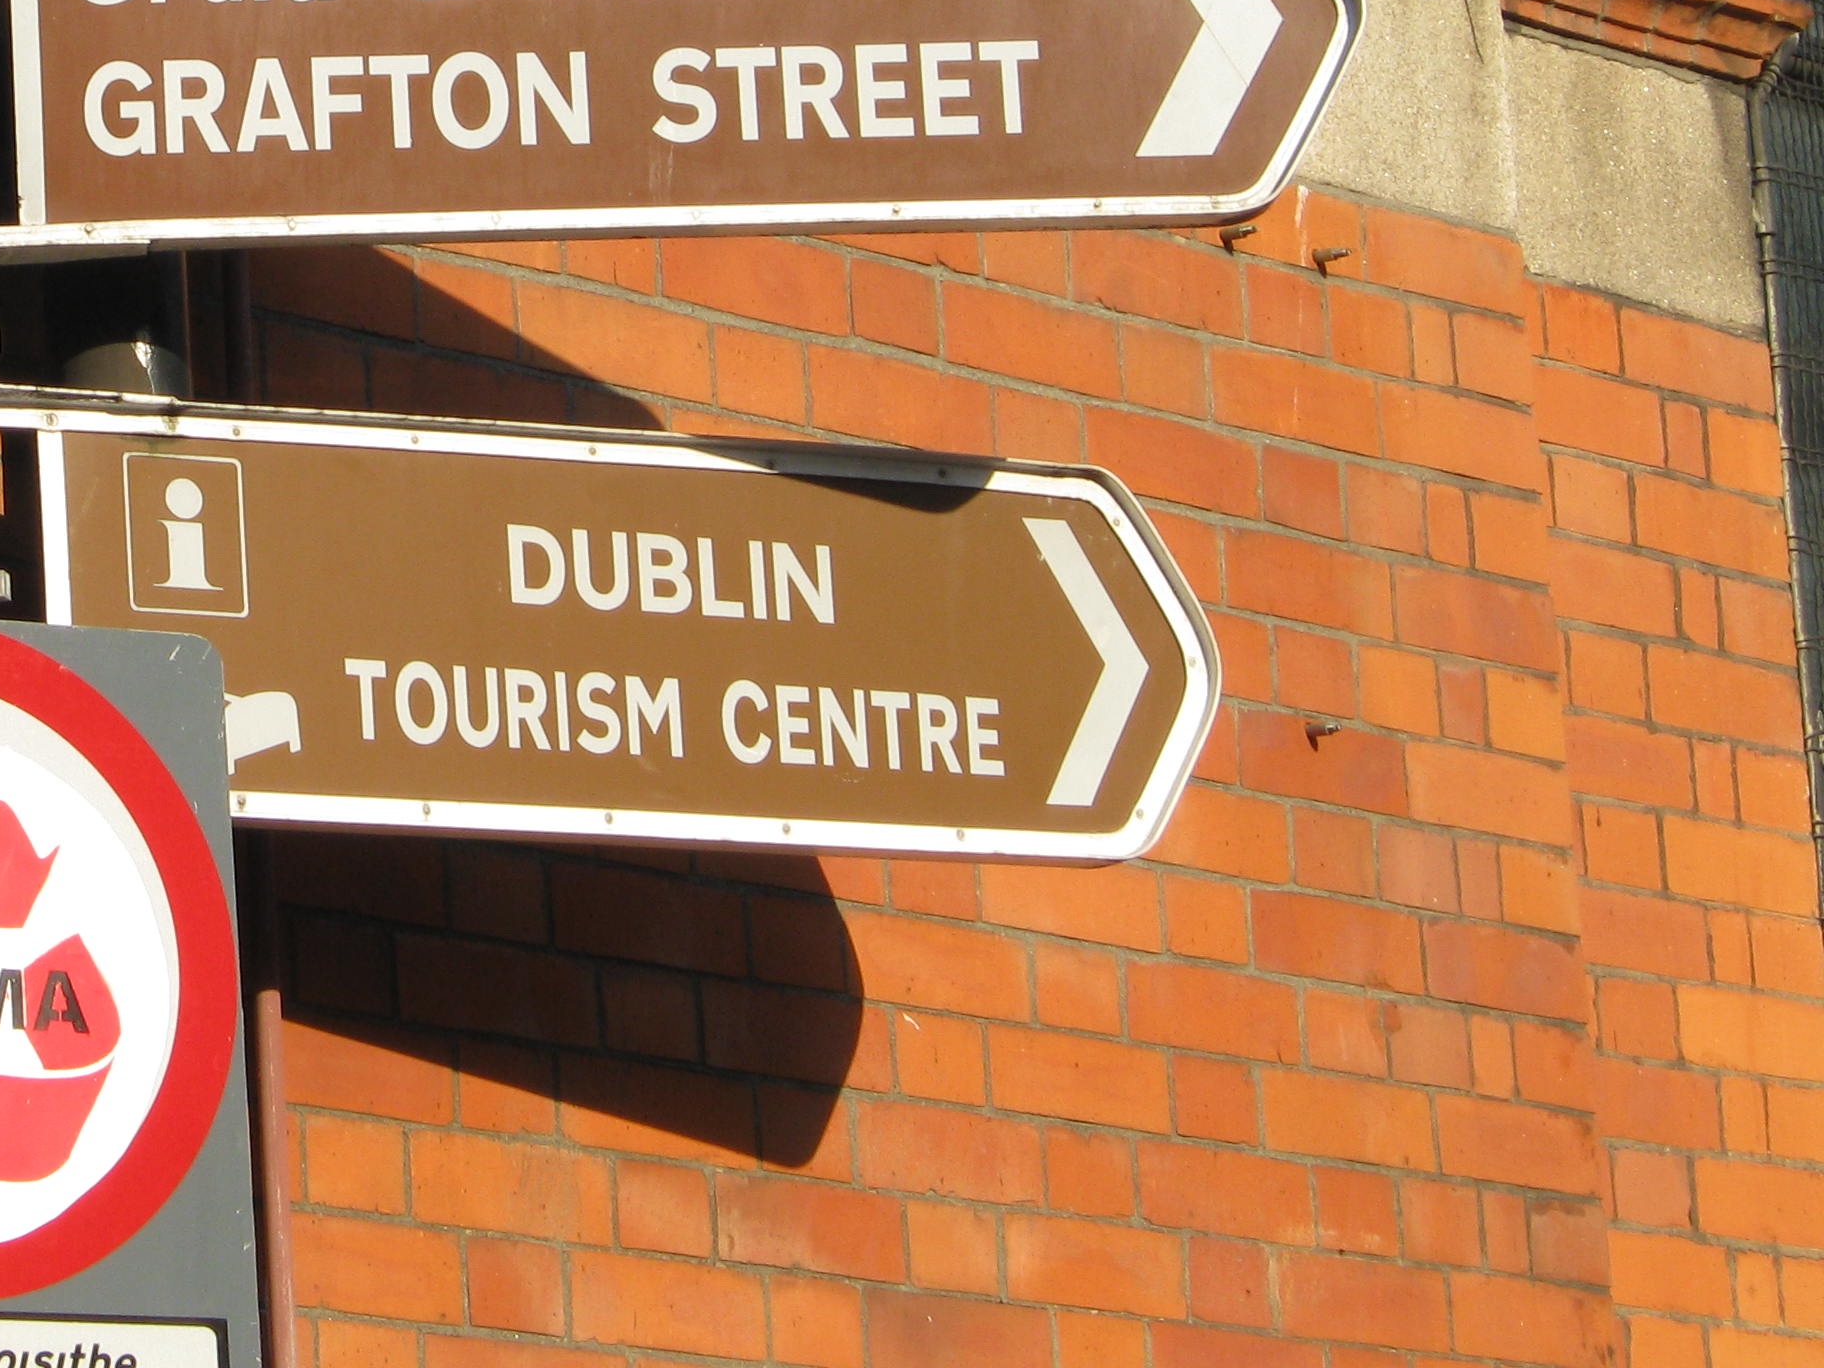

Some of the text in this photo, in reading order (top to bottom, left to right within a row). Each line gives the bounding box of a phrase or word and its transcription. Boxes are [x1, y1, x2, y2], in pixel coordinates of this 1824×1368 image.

[83, 40, 1039, 156] GRAFTON STREET
[507, 524, 835, 625] DUBLIN
[344, 658, 1006, 777] TOURISM CENTRE
